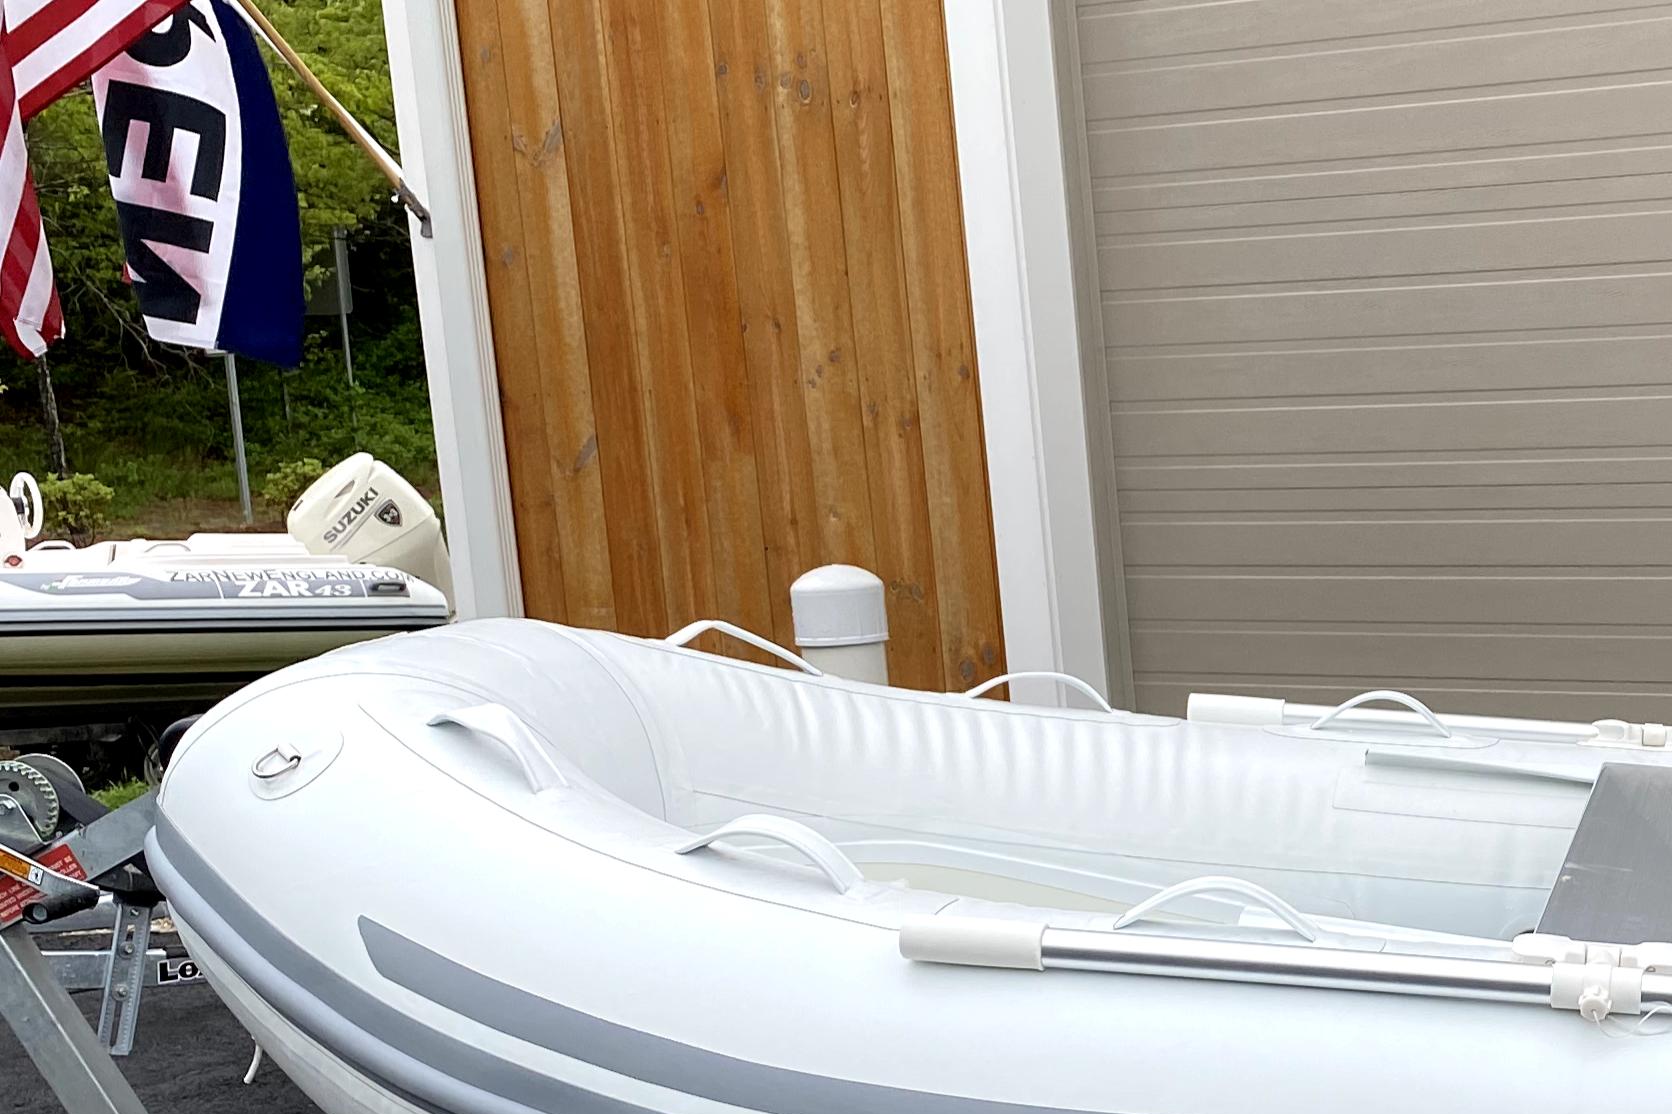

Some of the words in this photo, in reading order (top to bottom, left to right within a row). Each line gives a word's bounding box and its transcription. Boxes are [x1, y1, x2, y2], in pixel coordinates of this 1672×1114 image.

[323, 487, 379, 544] SUZUKI
[237, 580, 312, 597] ZAR
[157, 960, 206, 984] LO
